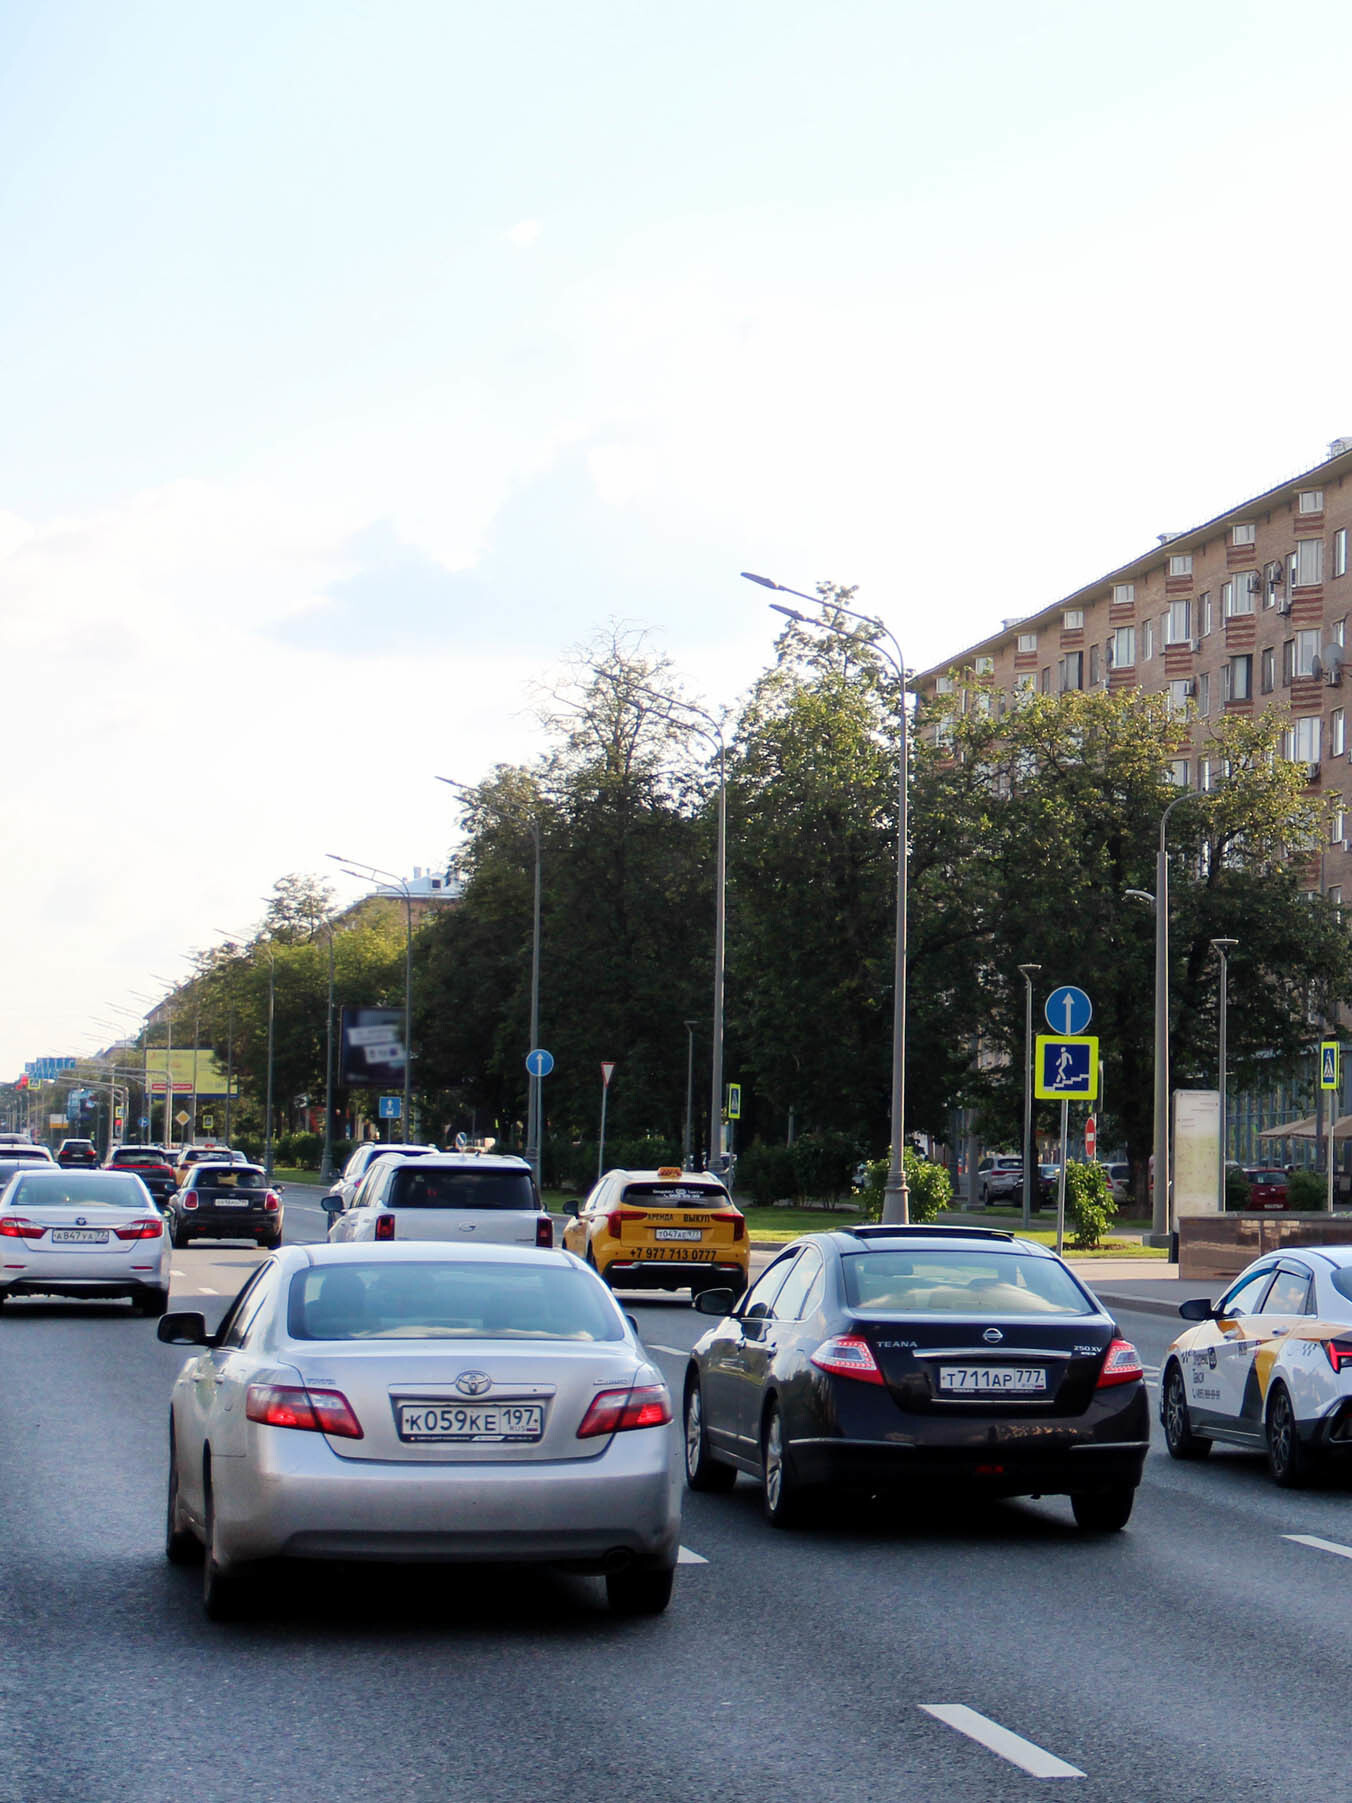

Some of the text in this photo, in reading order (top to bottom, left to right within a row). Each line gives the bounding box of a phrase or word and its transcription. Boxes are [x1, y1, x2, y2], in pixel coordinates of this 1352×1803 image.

[683, 1213, 711, 1223] ВЫКУП
[56, 1231, 94, 1240] А847УА
[630, 1247, 718, 1261] +7 977 713 0777
[876, 1340, 919, 1348] TEANA
[946, 1369, 1041, 1387] Т711АР 777
[409, 1408, 534, 1432] К059КЕ 197
